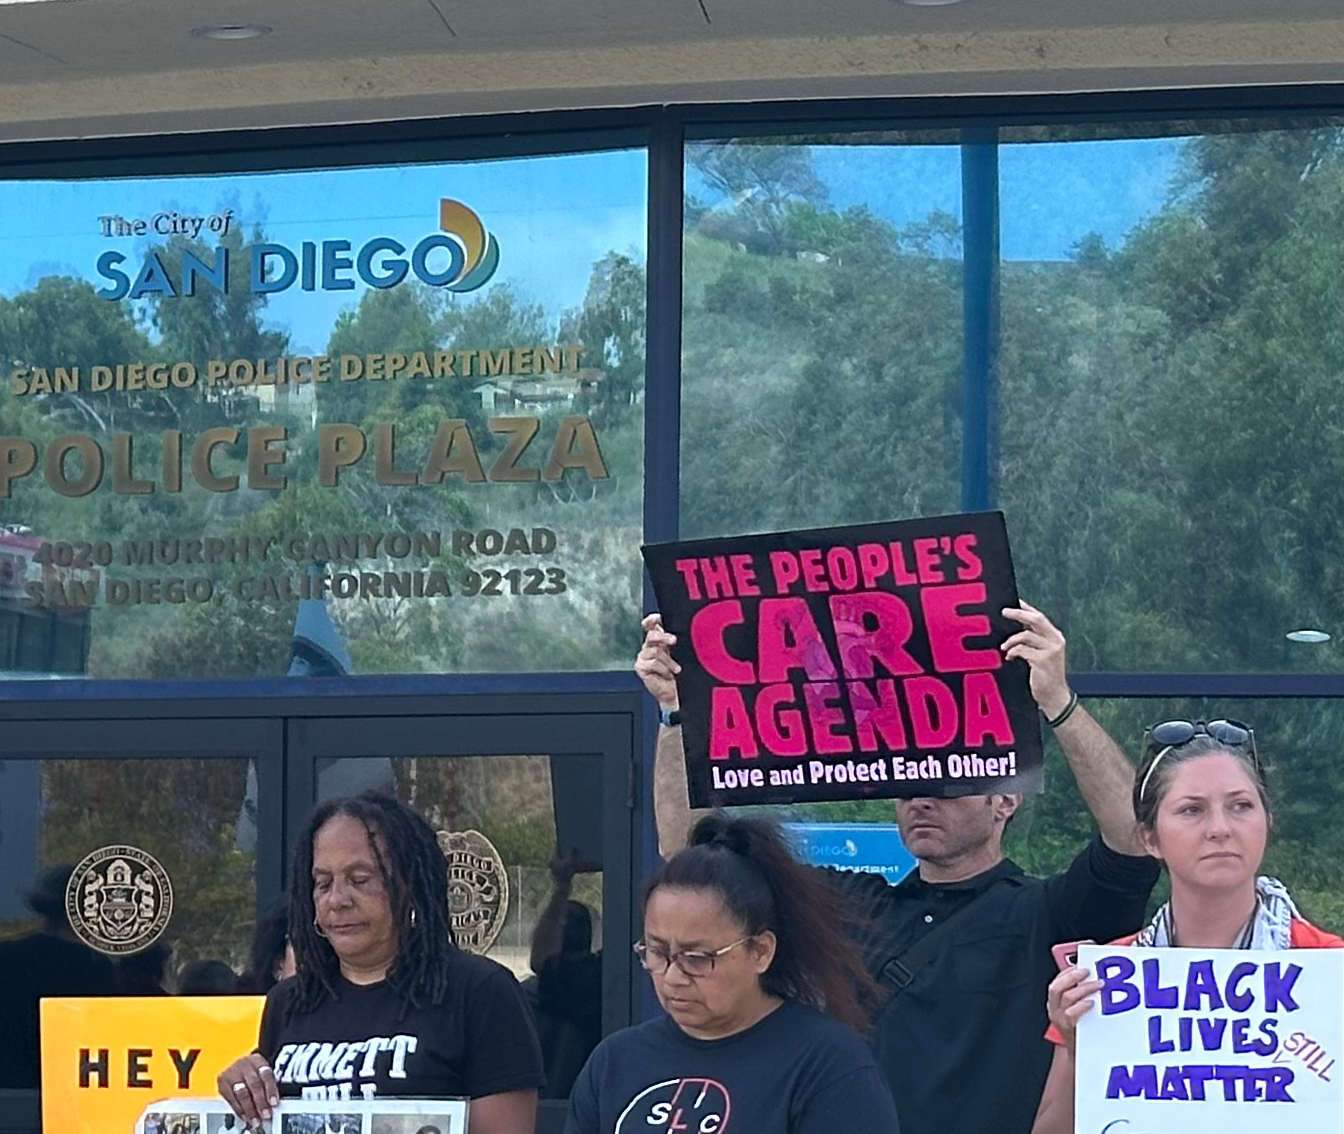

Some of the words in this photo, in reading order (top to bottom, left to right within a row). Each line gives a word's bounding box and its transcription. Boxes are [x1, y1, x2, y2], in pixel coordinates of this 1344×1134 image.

[98, 214, 148, 238] The
[152, 211, 205, 239] City
[208, 208, 235, 236] of
[96, 247, 228, 300] SAN
[250, 234, 466, 295] DIEGO
[12, 365, 79, 396] SAN
[91, 360, 196, 393] DIEGO
[208, 355, 330, 389] POLICE
[340, 345, 583, 382] DEPARTMENT
[318, 415, 609, 487] PLAZA
[33, 540, 112, 571] 4020
[123, 532, 275, 567] MURPHY
[286, 529, 441, 562] CANYON
[451, 527, 557, 558] ROAD
[675, 554, 759, 600] THE
[770, 533, 983, 595] PEOPLE'S
[24, 580, 102, 608] SAN
[111, 575, 221, 607] DIEGO,
[233, 568, 451, 602] CALIFORNIA
[460, 566, 567, 597] 92123
[690, 582, 1003, 686] CARE
[708, 672, 1015, 761] AGENDA
[712, 764, 764, 790] Love
[769, 765, 805, 786] and
[809, 756, 888, 784] Protect
[893, 755, 943, 781] Each
[948, 752, 1016, 779] Other!
[1095, 955, 1304, 1016] BLACK
[78, 1048, 202, 1089] HEY
[273, 1034, 418, 1084] EMMETT
[1148, 1016, 1280, 1057] LIVES
[1282, 1031, 1336, 1084] STILL
[1105, 1064, 1296, 1103] MATTER
